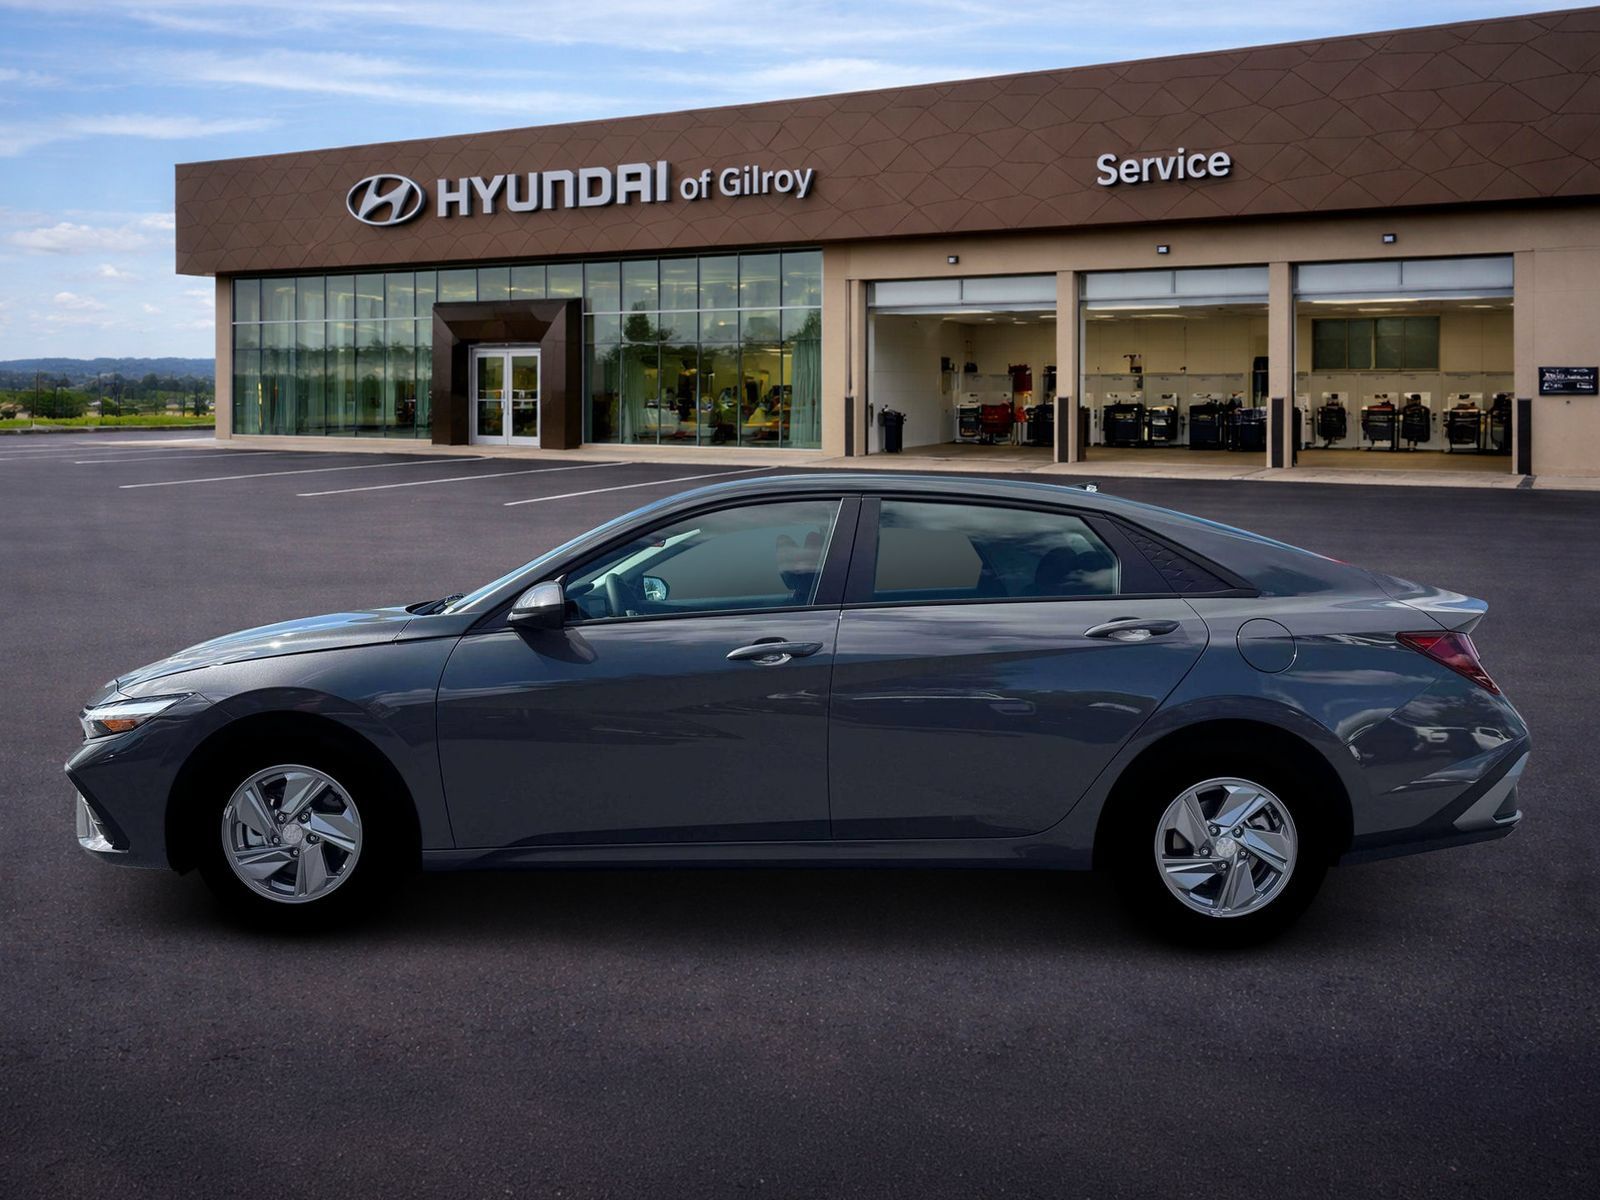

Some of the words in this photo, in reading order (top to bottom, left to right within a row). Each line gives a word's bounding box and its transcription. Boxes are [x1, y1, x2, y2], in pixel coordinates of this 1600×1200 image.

[436, 160, 669, 217] HYUNDAI
[679, 168, 711, 200] of
[718, 164, 813, 199] Gilroy
[1096, 147, 1232, 187] Service
